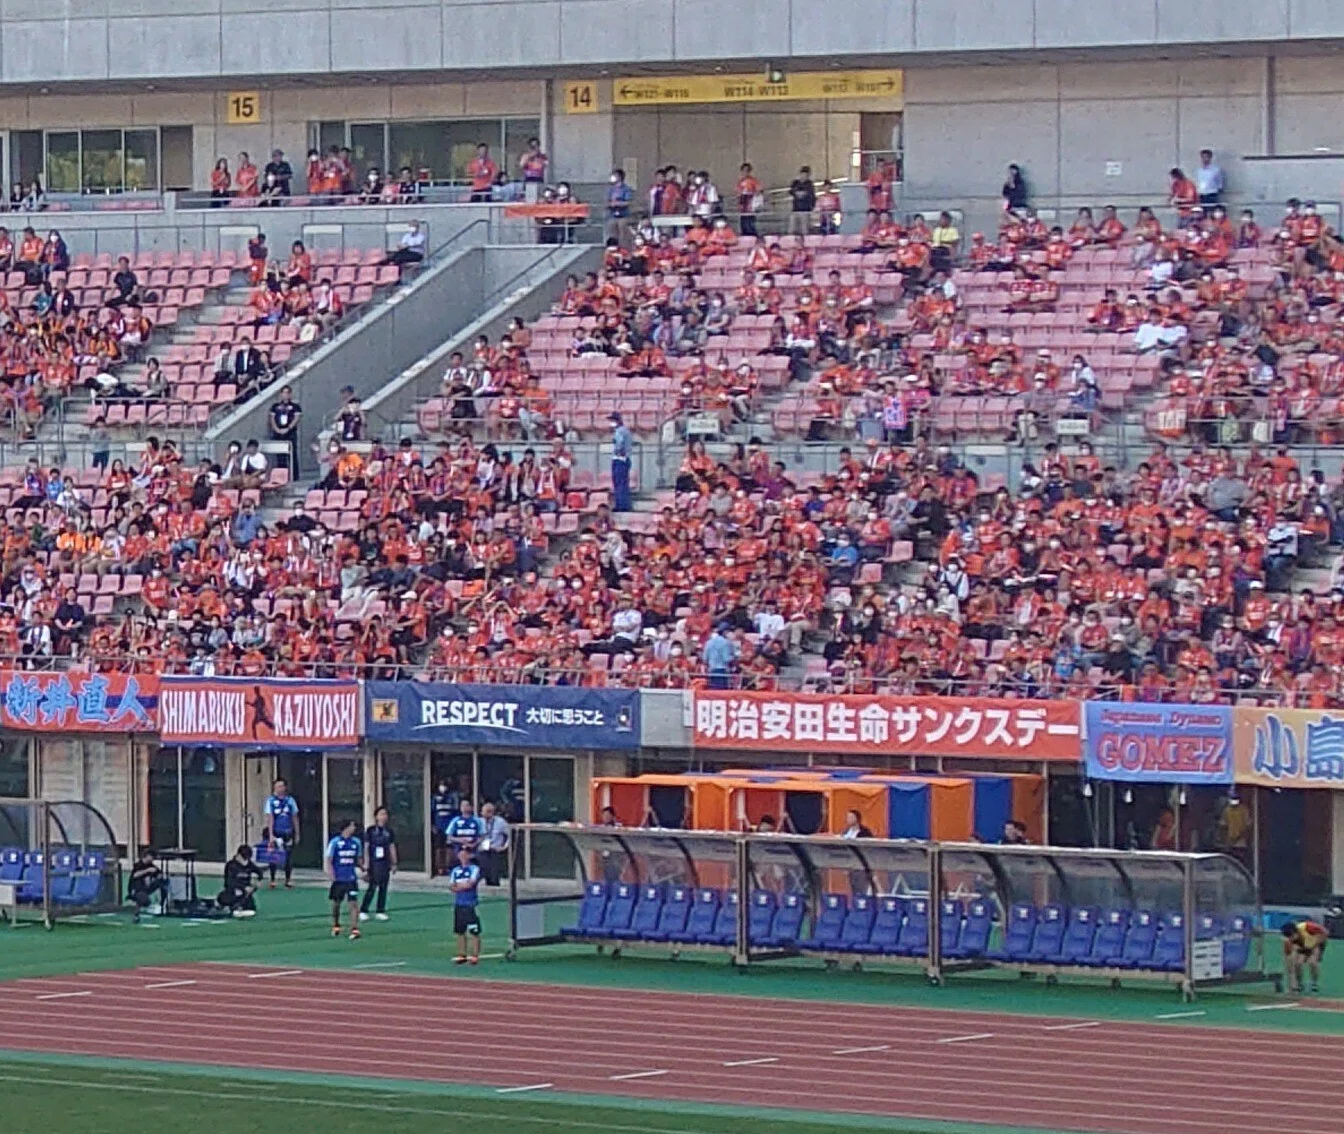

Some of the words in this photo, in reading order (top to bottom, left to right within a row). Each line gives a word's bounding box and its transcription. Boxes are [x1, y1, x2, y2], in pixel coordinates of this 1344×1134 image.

[232, 97, 254, 118] 15
[570, 86, 591, 107] 14
[5, 674, 150, 726] 新井直人
[162, 690, 246, 736] SHIMABUKU
[272, 693, 357, 738] KAZUYOSHI
[421, 700, 519, 726] RESPECT
[525, 709, 605, 726] 大切に思うこと
[696, 699, 1080, 747] 明治安田生命サンクスデー
[1097, 732, 1227, 775] GOMEZ
